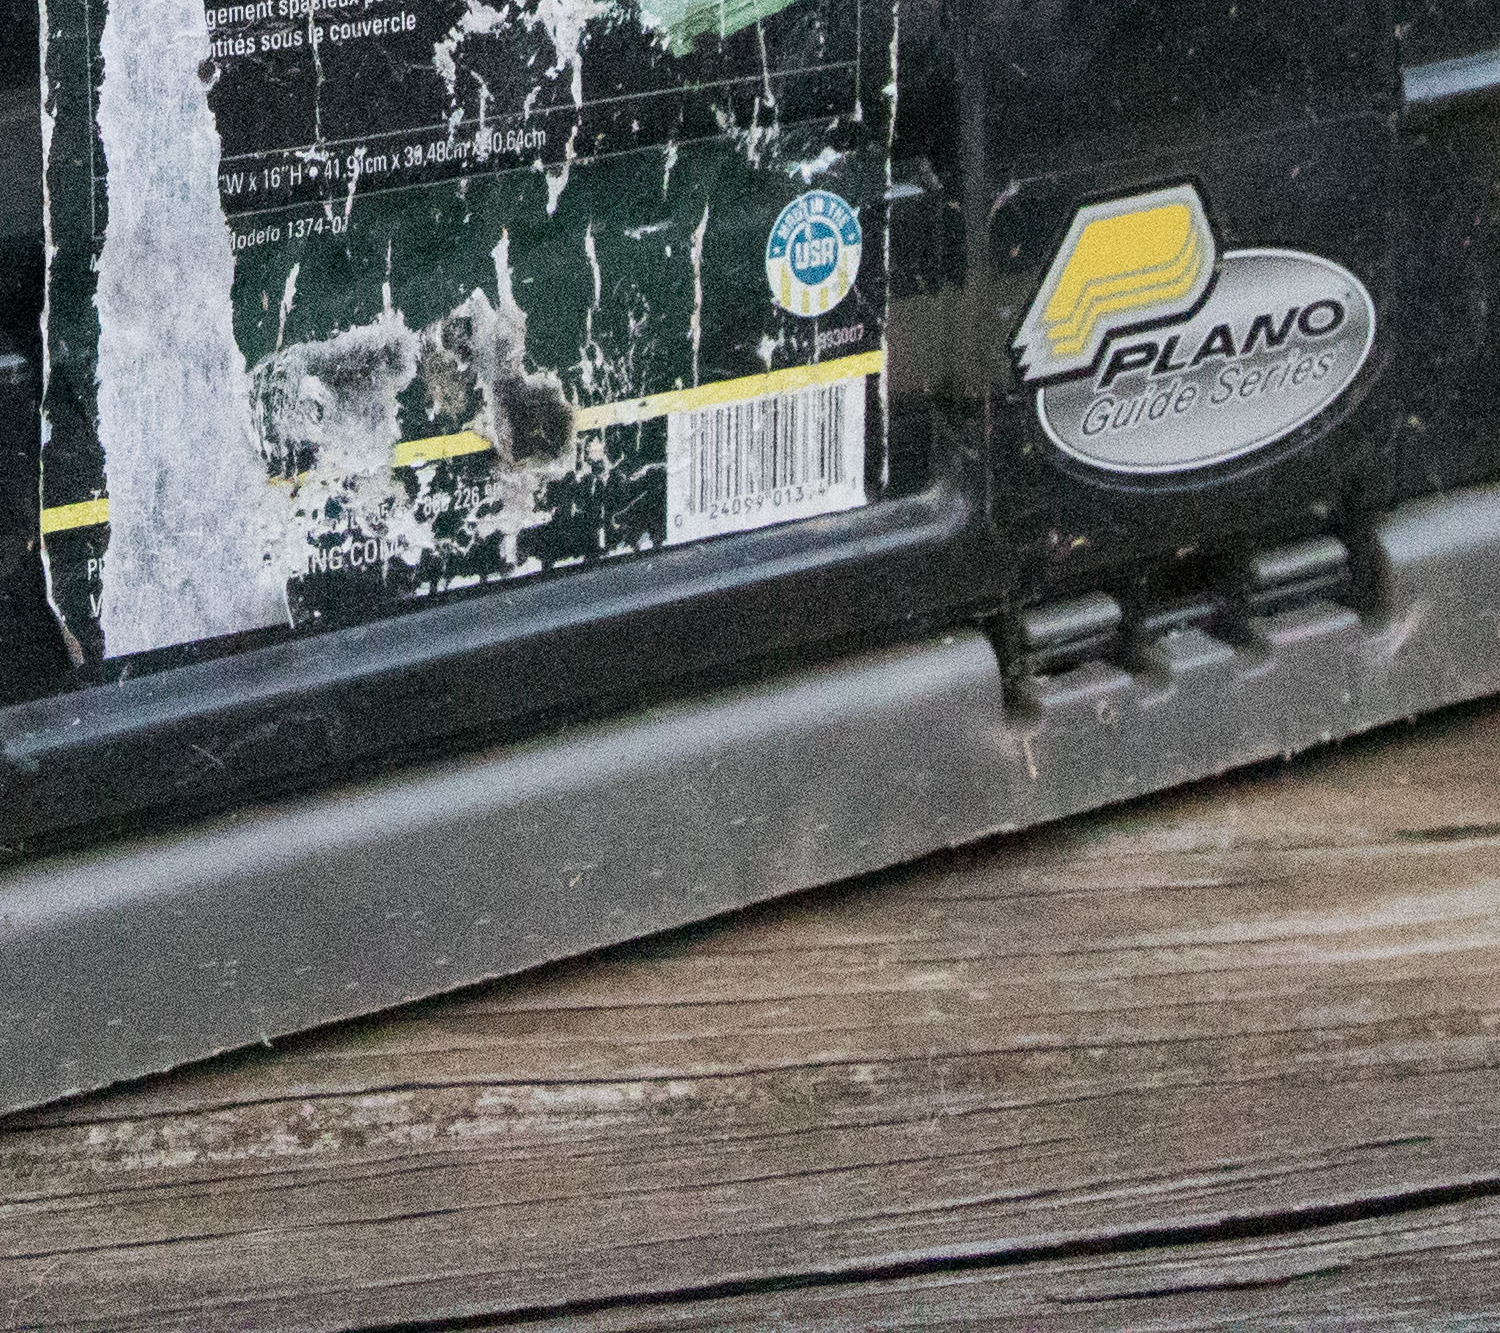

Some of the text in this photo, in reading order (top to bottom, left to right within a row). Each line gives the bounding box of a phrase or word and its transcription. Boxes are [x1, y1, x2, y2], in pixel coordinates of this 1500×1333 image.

[260, 29, 303, 53] sous
[308, 24, 324, 44] le
[329, 9, 417, 42] couvercle
[794, 236, 836, 271] USA
[1100, 297, 1344, 389] PLANO
[1081, 346, 1336, 436] Guide Series
